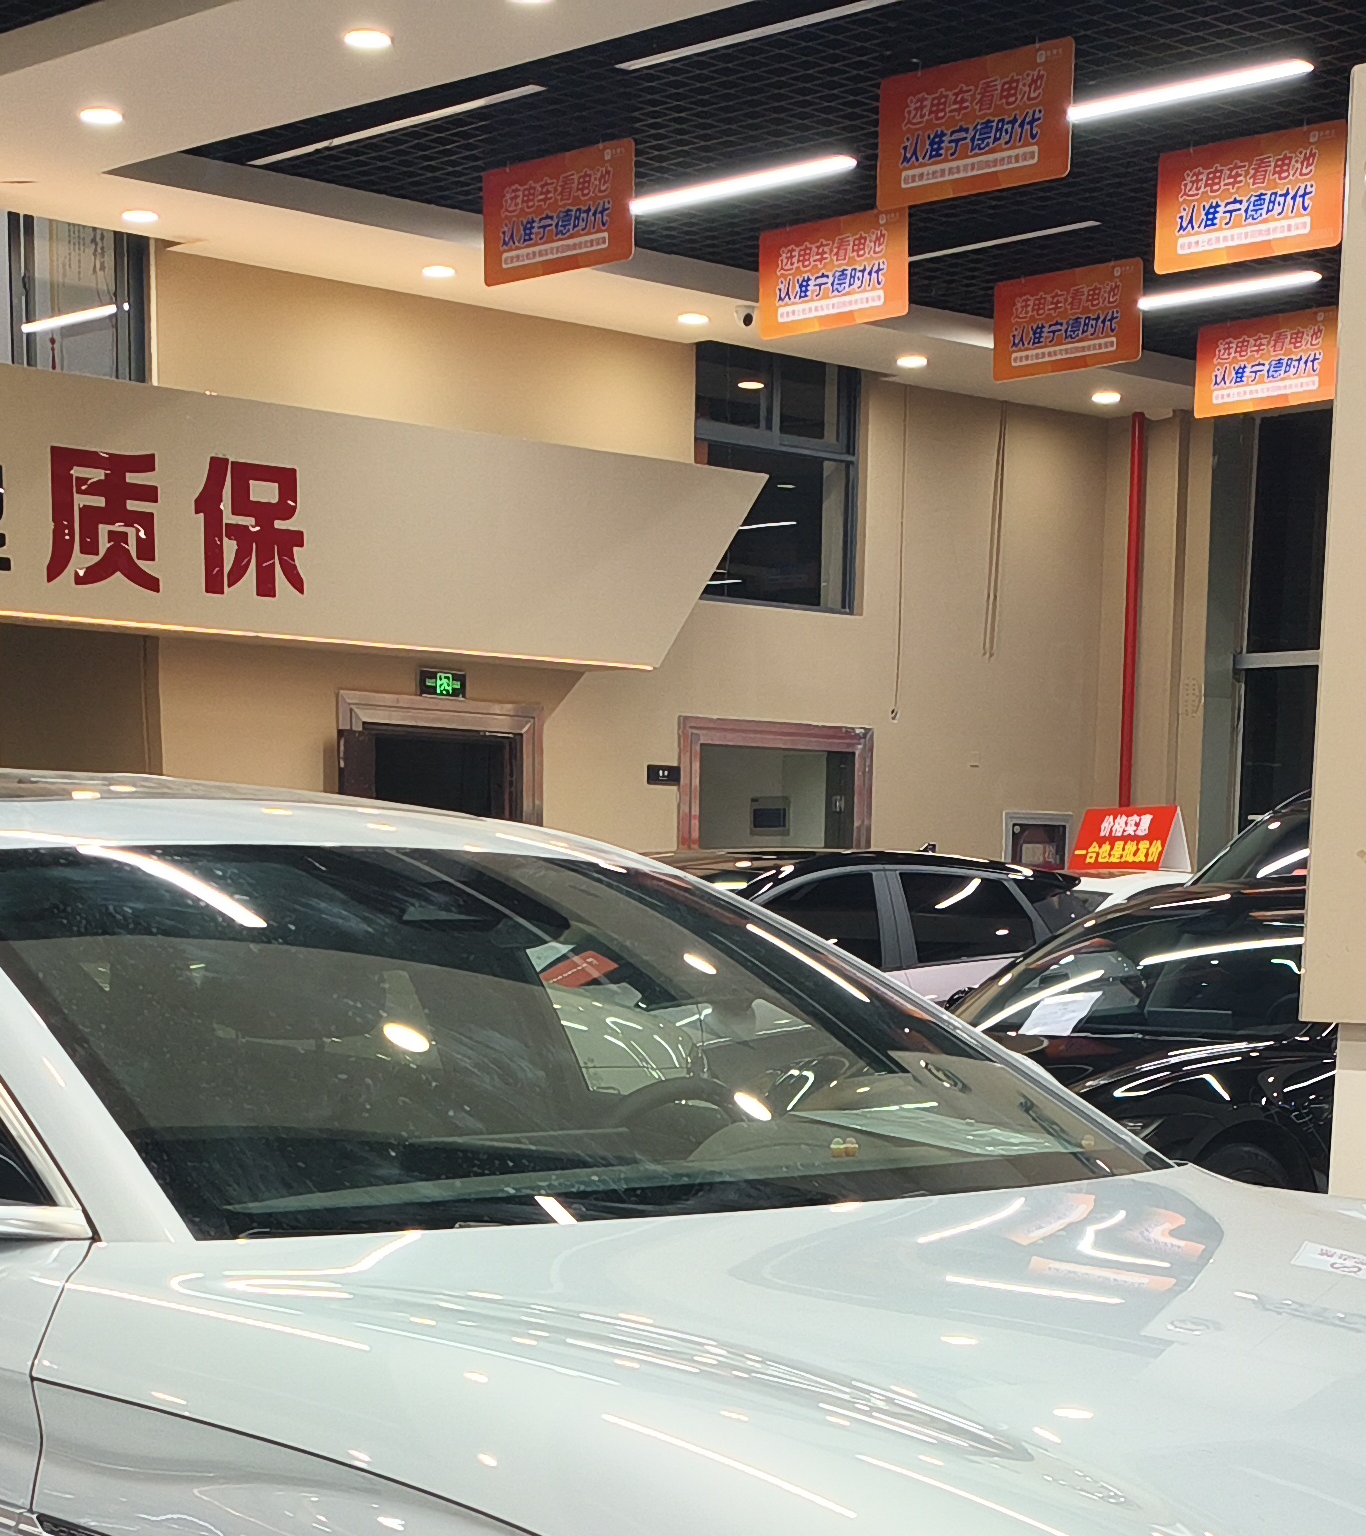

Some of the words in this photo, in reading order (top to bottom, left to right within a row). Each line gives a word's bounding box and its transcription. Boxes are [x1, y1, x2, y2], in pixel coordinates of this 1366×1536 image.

[902, 84, 974, 130] 选电车
[974, 67, 1046, 113] 看电池
[899, 108, 1044, 168] 认准宁德时代
[502, 177, 556, 217] 选电车
[556, 164, 613, 204] 看电池
[1179, 160, 1248, 201] 选电车
[1248, 145, 1318, 188] 看电池
[500, 199, 611, 249] 认准宁德时代
[1176, 182, 1316, 236] 认准宁德时代
[777, 239, 831, 274] 选电车
[832, 228, 887, 262] 看电池
[776, 260, 887, 306] 认准宁德时代
[1011, 290, 1066, 322] 选电车
[1066, 279, 1122, 312] 看电池
[1010, 309, 1121, 350] 认准宁德时代
[1214, 333, 1268, 363] 选电车
[1270, 323, 1324, 354] 看电池
[1211, 350, 1323, 390] 认准宁德时代
[1099, 813, 1153, 837] 价格实惠
[1074, 839, 1162, 864] 一台也是批发价
